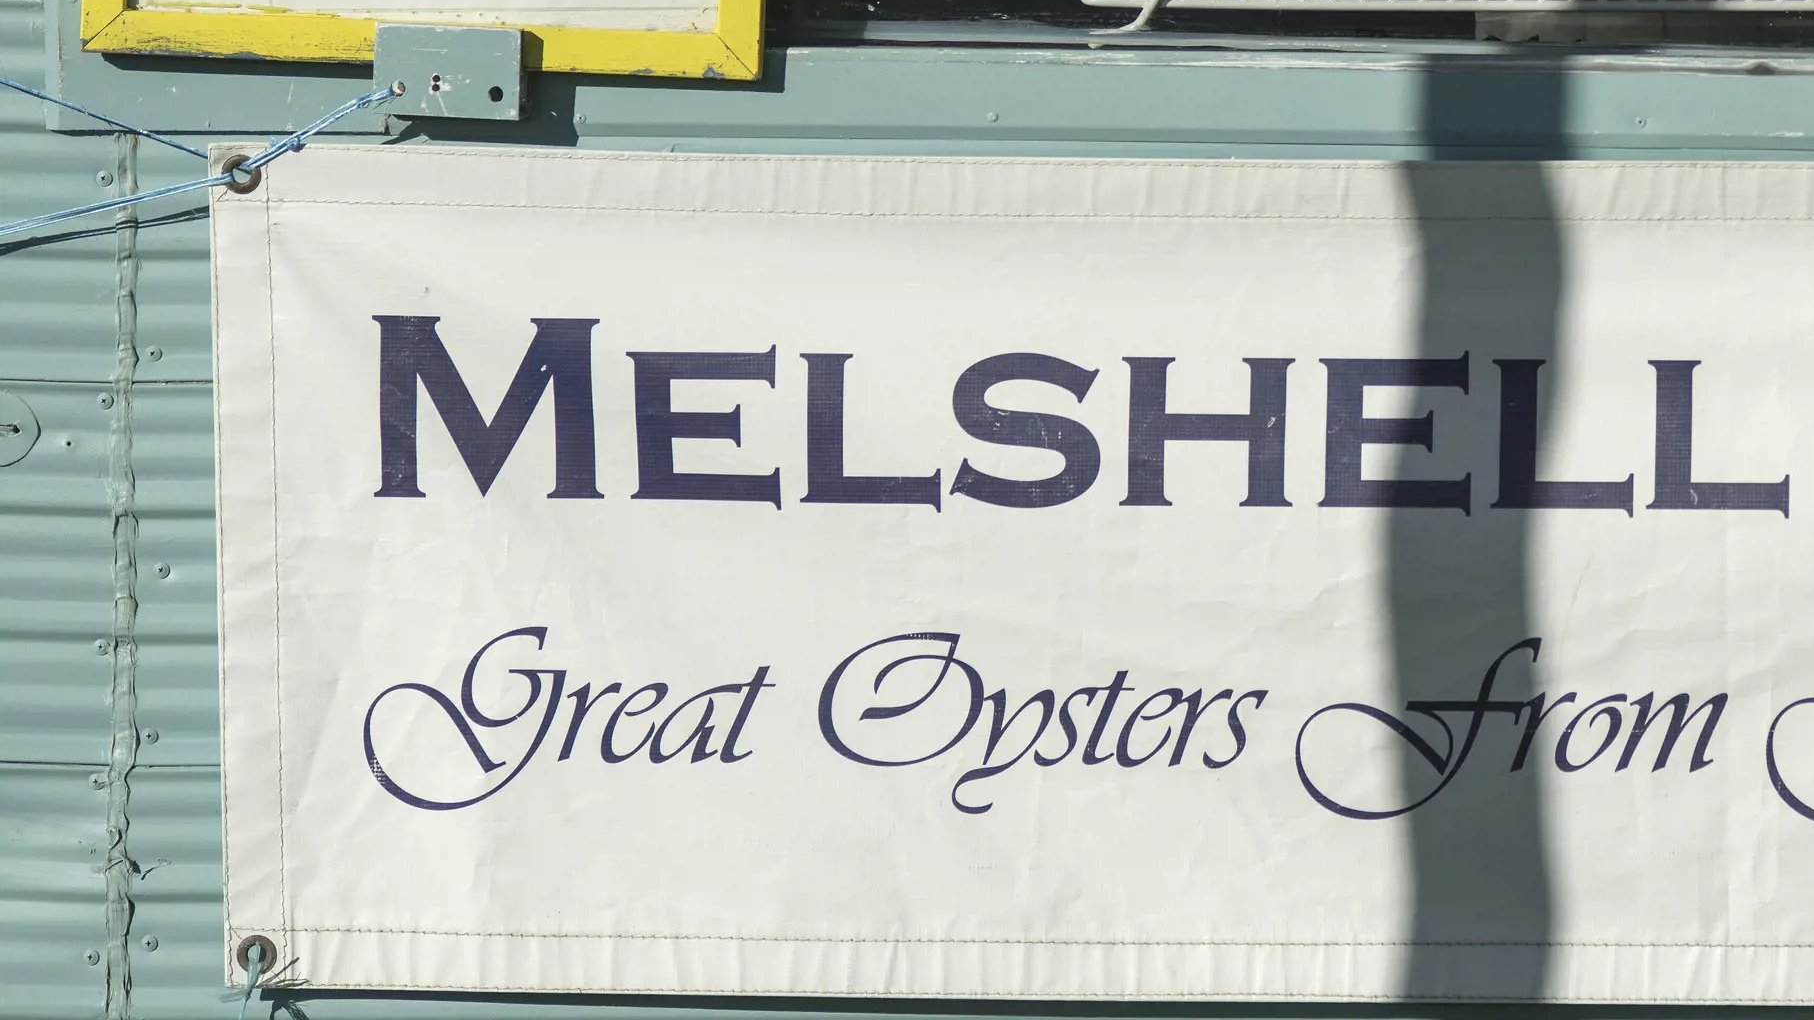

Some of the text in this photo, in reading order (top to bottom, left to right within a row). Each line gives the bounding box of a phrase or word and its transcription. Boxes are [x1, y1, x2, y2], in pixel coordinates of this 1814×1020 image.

[372, 316, 1791, 517] MELSHELL
[364, 626, 772, 812] Great
[818, 632, 1270, 816] Oysters
[1296, 637, 1729, 821] From
